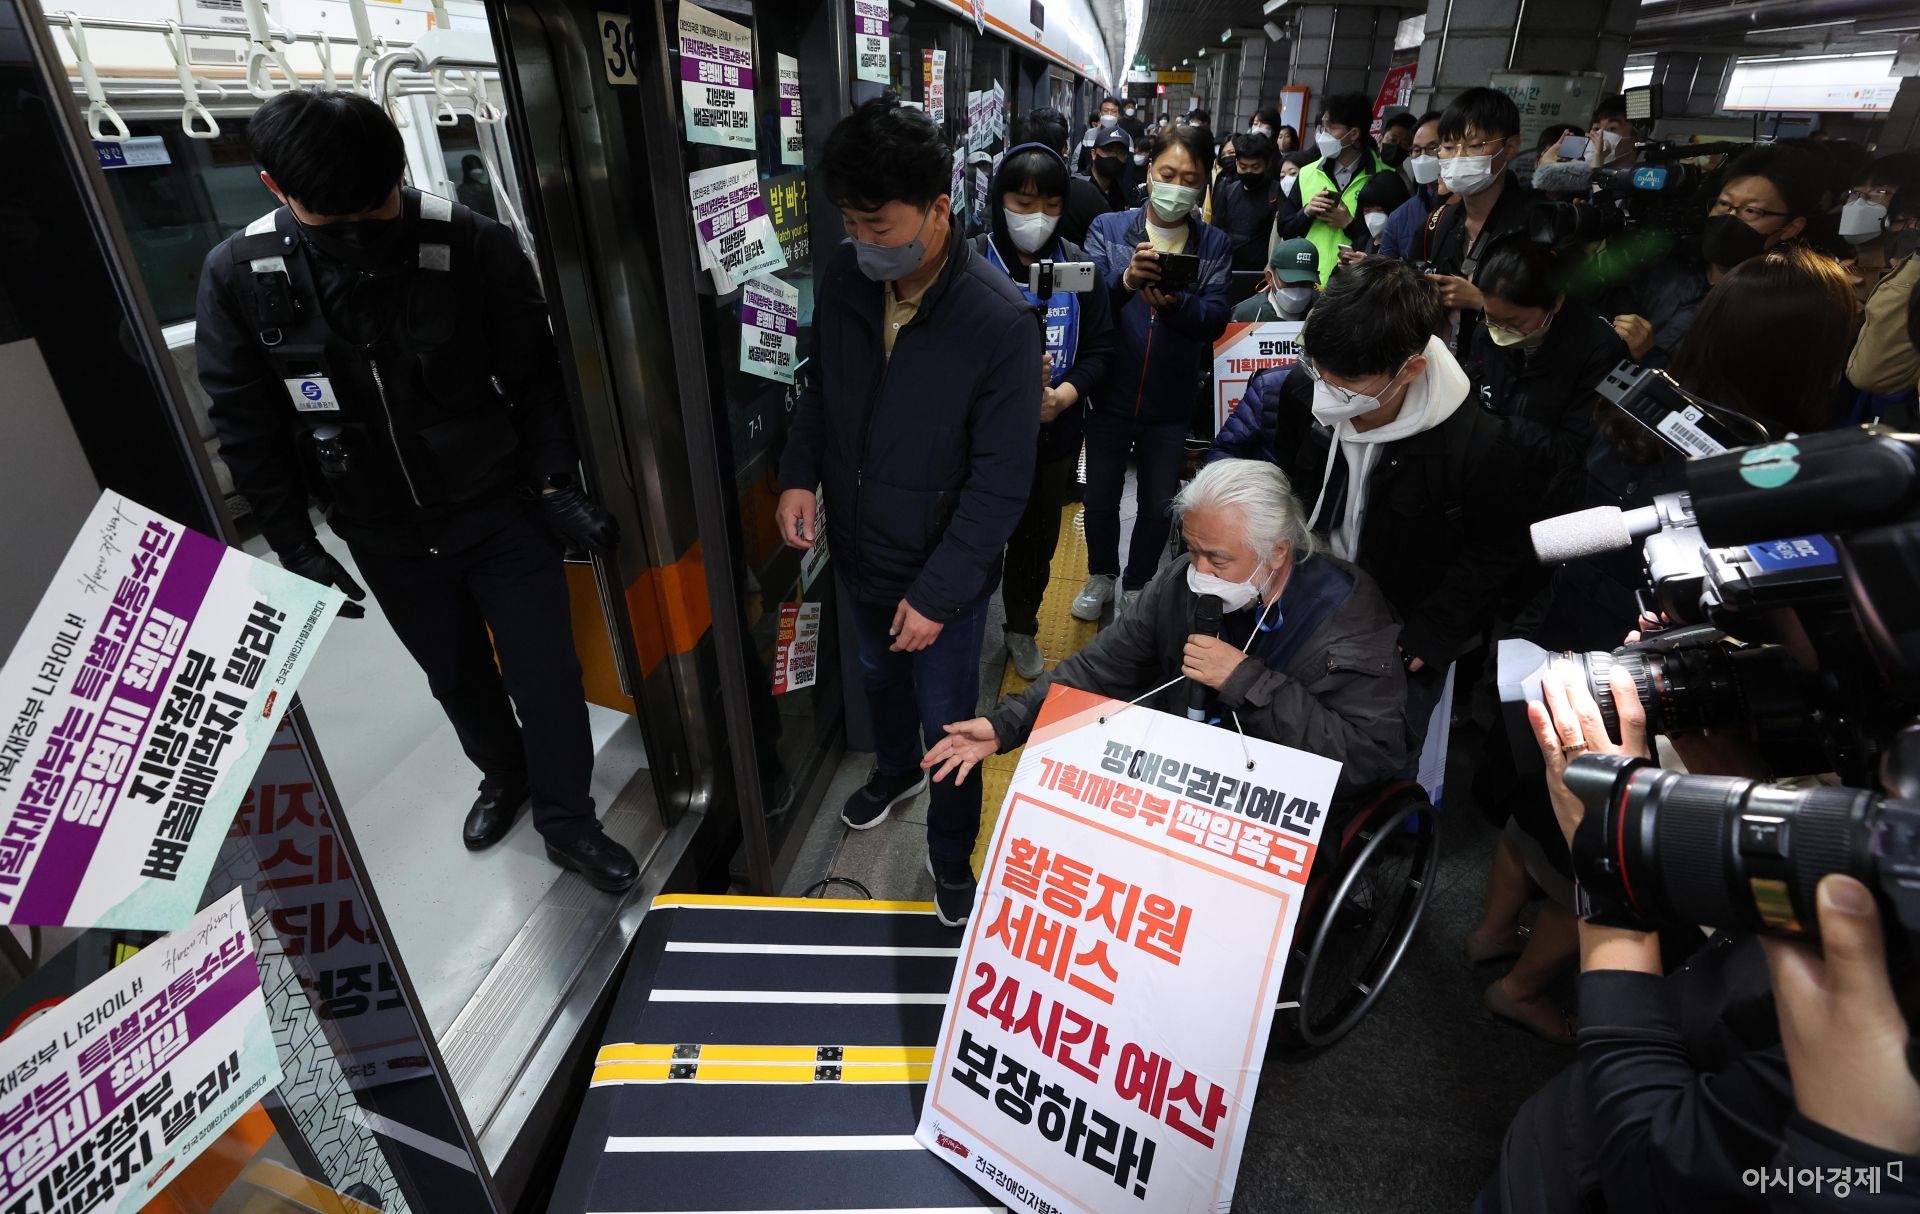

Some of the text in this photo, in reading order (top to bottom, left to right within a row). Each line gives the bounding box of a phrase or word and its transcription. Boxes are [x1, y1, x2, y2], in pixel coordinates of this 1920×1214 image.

[748, 414, 762, 439] 7-1
[32, 612, 87, 696] 나라이냐!
[70, 520, 175, 701] 특별교통수단
[222, 601, 287, 690] 말라!
[62, 607, 188, 828] 운영비 책임
[127, 649, 217, 804] 지방정부
[1038, 757, 1308, 876] 기획재정부 책임촉구
[1100, 740, 1321, 836] 장애인권리예산
[985, 896, 1119, 1005] 서비스
[1001, 837, 1193, 966] 활동지원
[64, 977, 143, 1049] 나라이냐!
[77, 930, 246, 1080] 특별교통수단
[110, 1011, 190, 1098] 책임
[967, 961, 1227, 1150] 24시간 예산
[5, 1070, 174, 1214] 지방정부
[161, 1050, 241, 1147] 말라!
[951, 1029, 1157, 1201] 보장하라!
